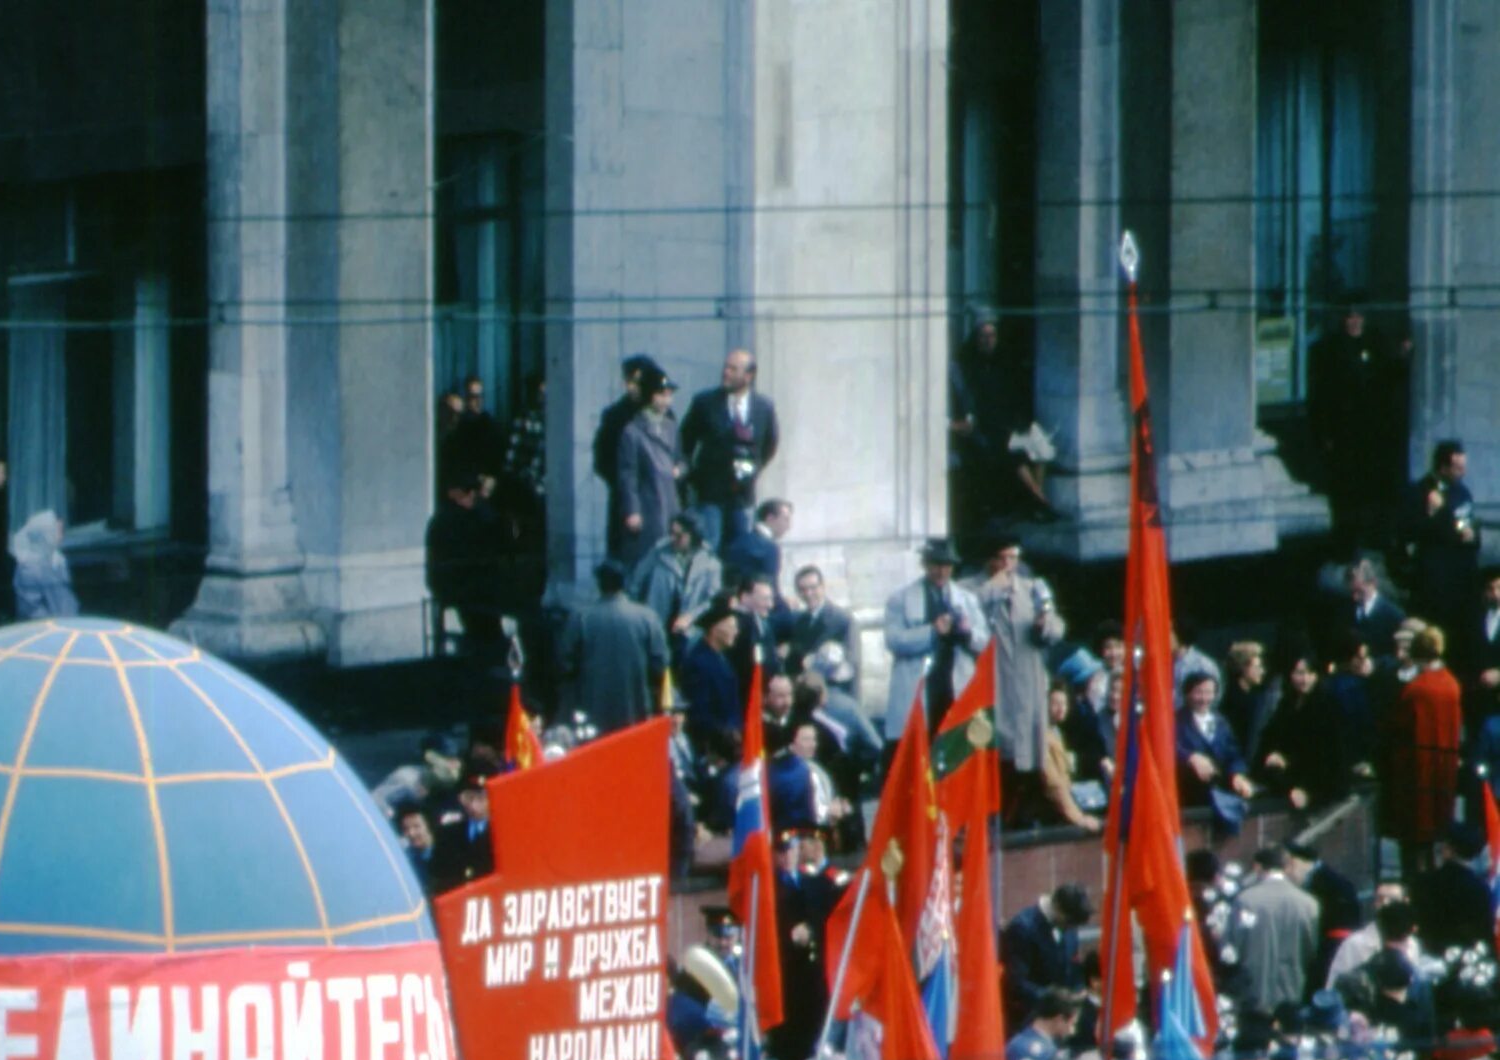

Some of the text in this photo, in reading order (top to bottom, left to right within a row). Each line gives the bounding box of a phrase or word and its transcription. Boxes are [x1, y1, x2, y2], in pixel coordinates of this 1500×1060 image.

[461, 874, 662, 945] ДА ЗДРАВСТВУЕТ
[485, 924, 660, 989] МИР И ДРУЖБА
[579, 971, 661, 1023] МЕЖДУ
